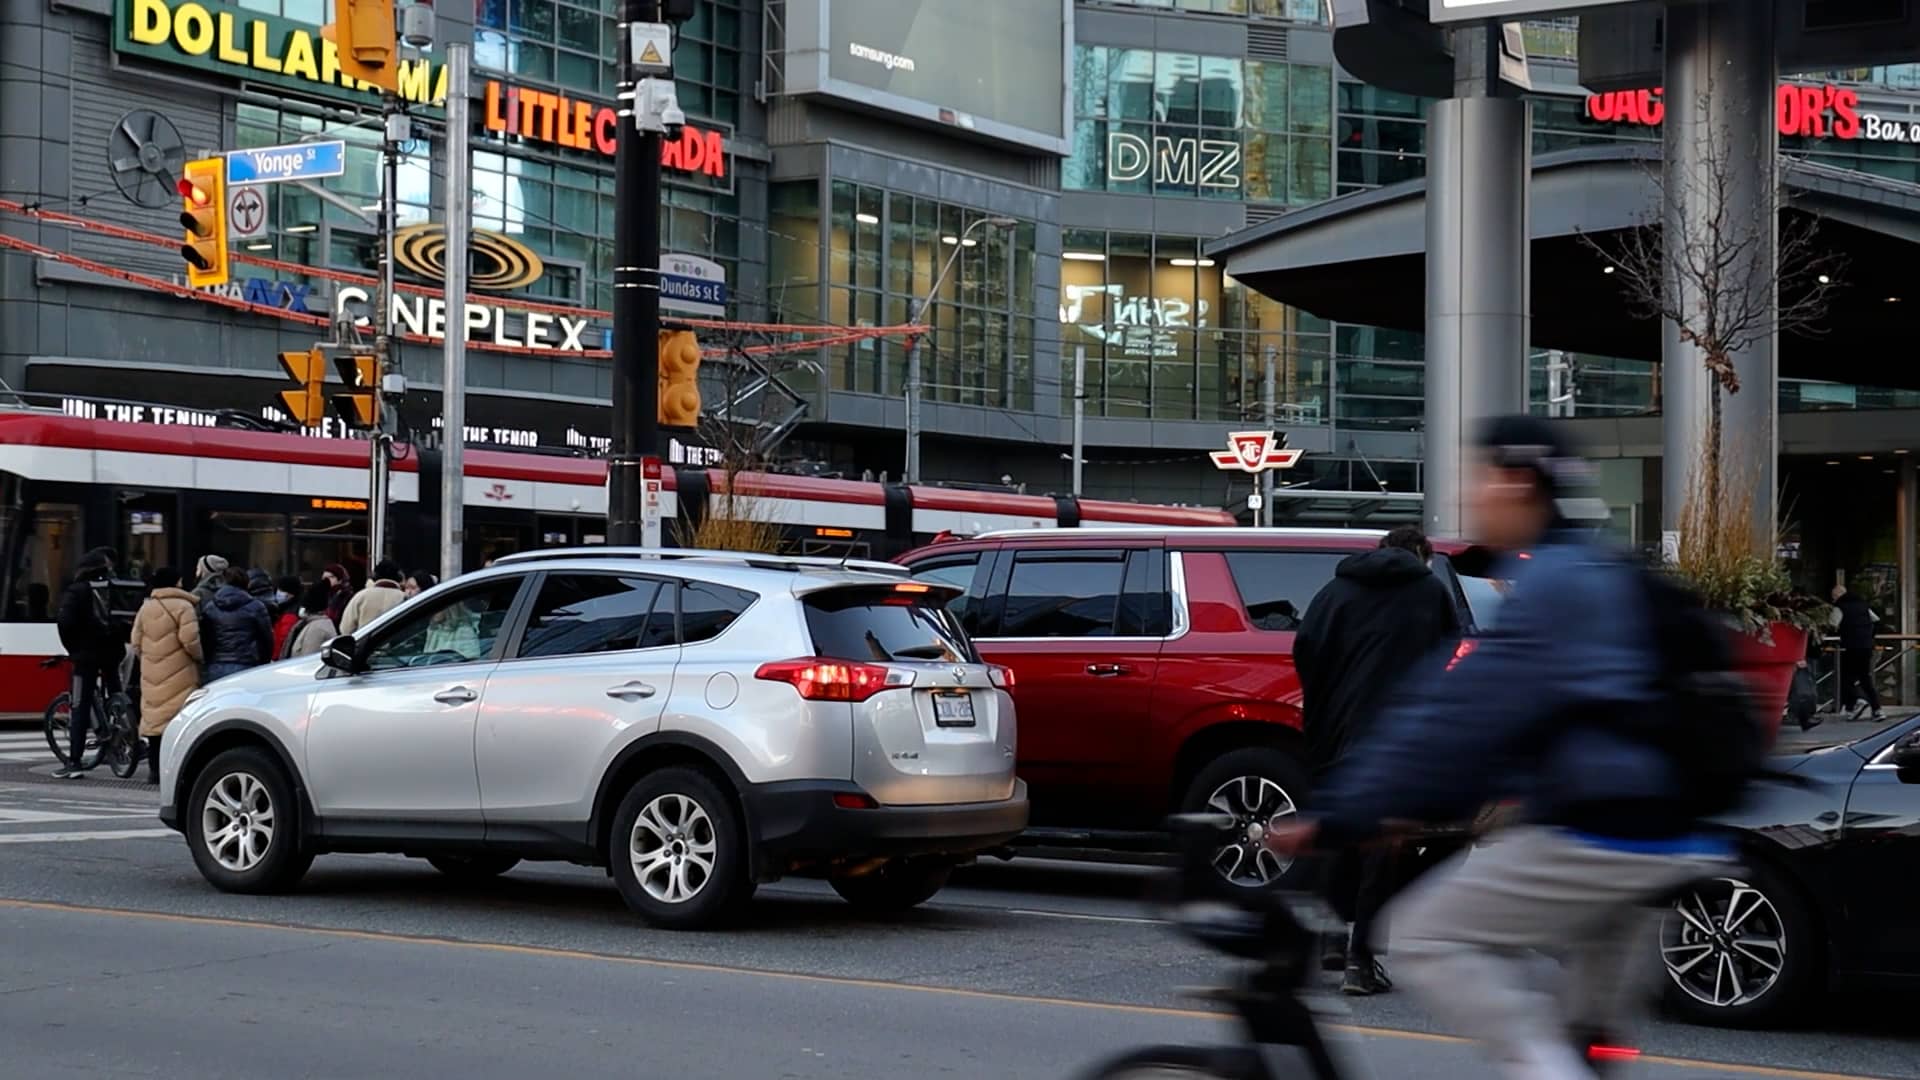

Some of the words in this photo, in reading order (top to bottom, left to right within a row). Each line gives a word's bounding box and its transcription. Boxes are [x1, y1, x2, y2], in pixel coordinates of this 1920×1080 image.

[850, 42, 915, 72] samsung.com
[485, 80, 591, 149] LITTLE
[595, 108, 724, 177] CADA
[1589, 87, 1665, 125] JAC
[1863, 113, 1905, 141] Bar
[254, 152, 304, 177] Yonge
[1109, 132, 1240, 187] DMZ
[660, 276, 702, 299] Dundas
[713, 284, 721, 301] E
[337, 286, 587, 352] CNEPLEX
